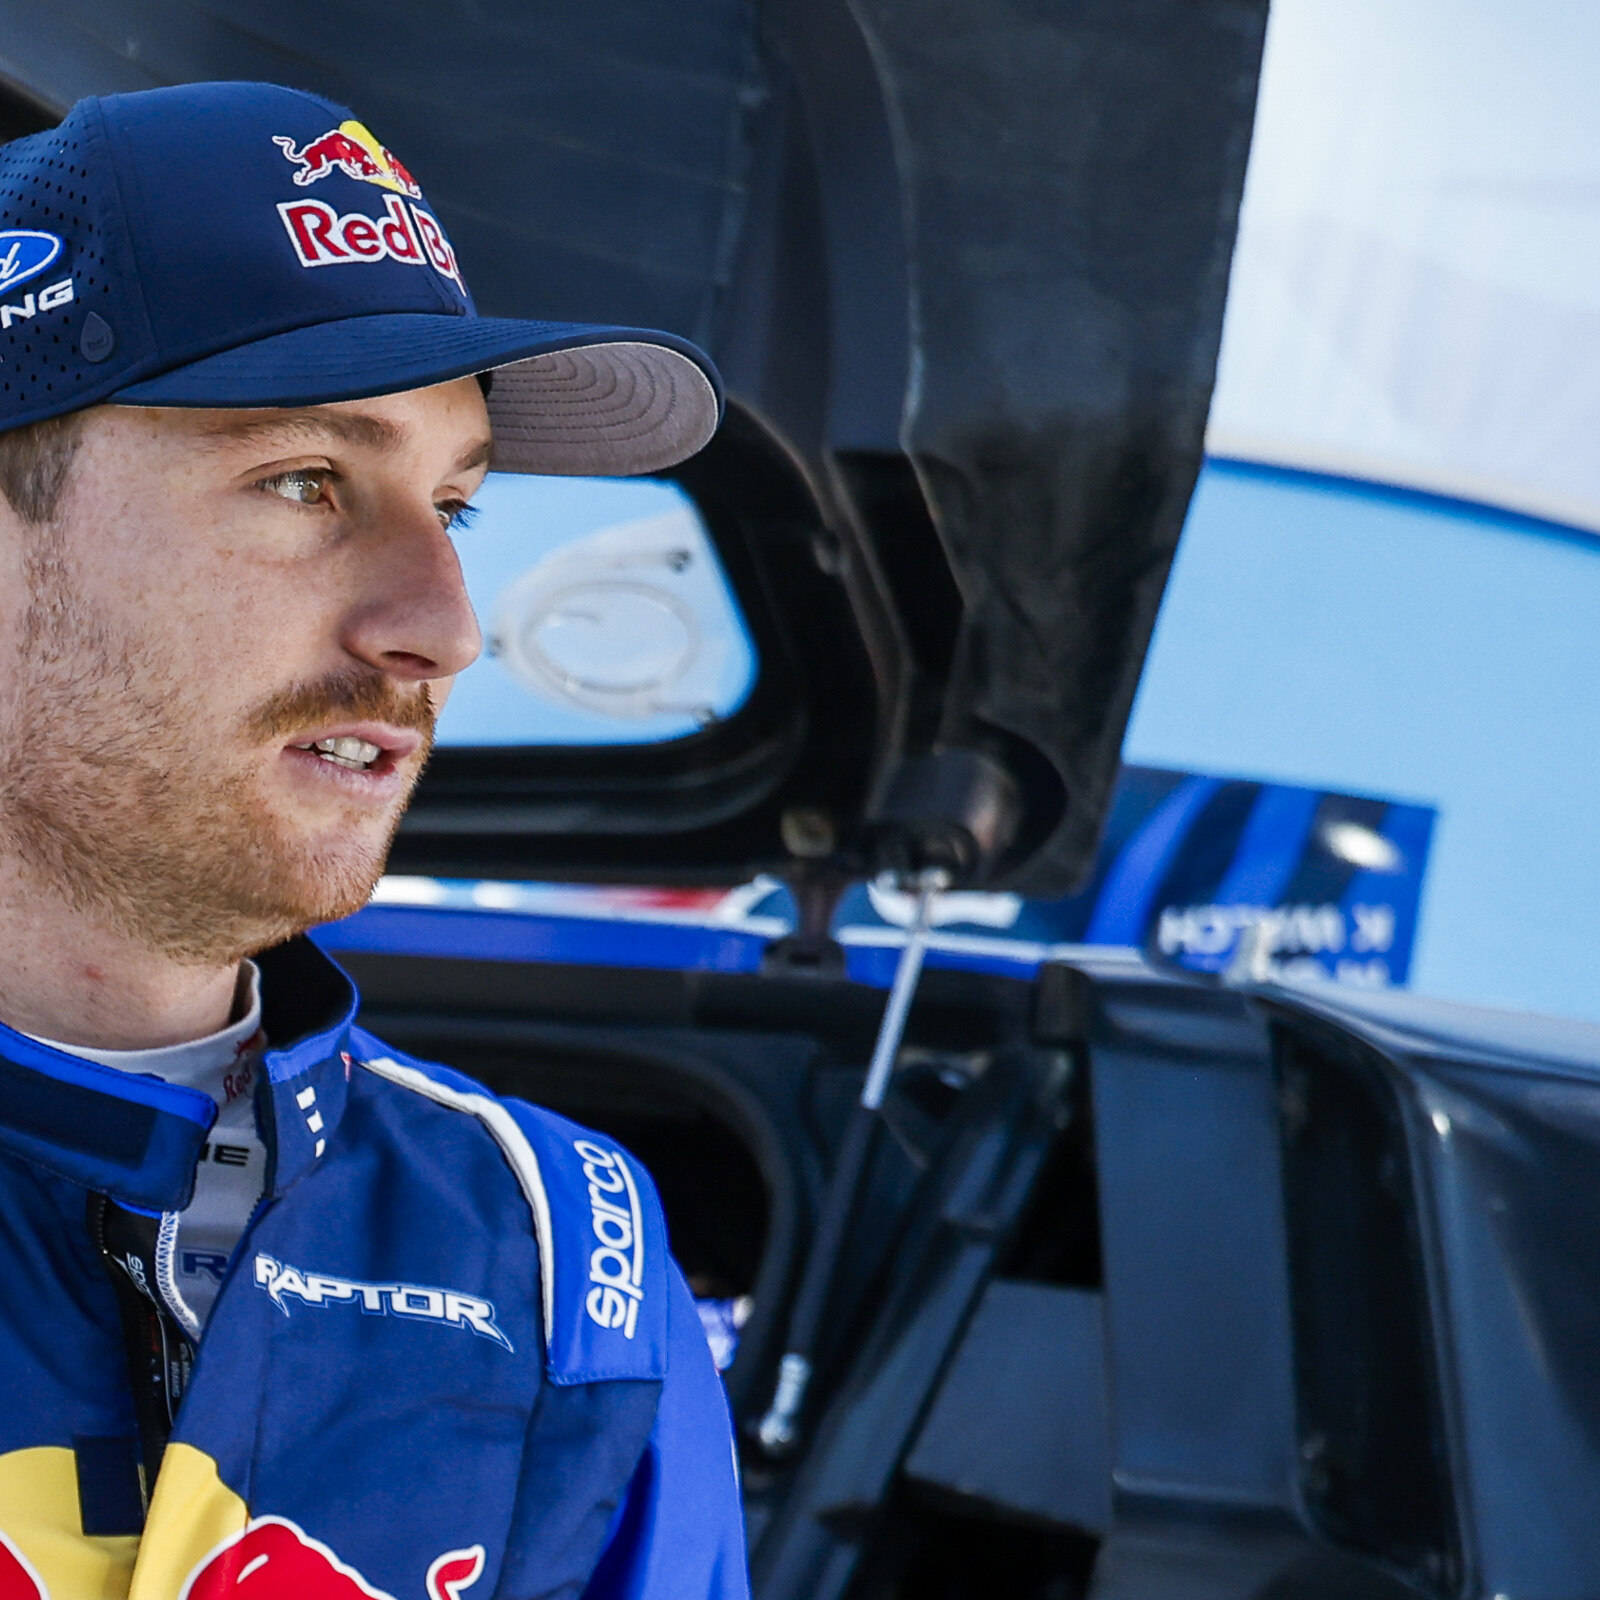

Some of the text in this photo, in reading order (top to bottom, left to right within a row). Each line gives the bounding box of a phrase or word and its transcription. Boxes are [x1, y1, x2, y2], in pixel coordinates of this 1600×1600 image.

[279, 196, 424, 265] Red
[574, 1140, 644, 1334] sparco
[254, 1253, 512, 1350] RAPTOR
